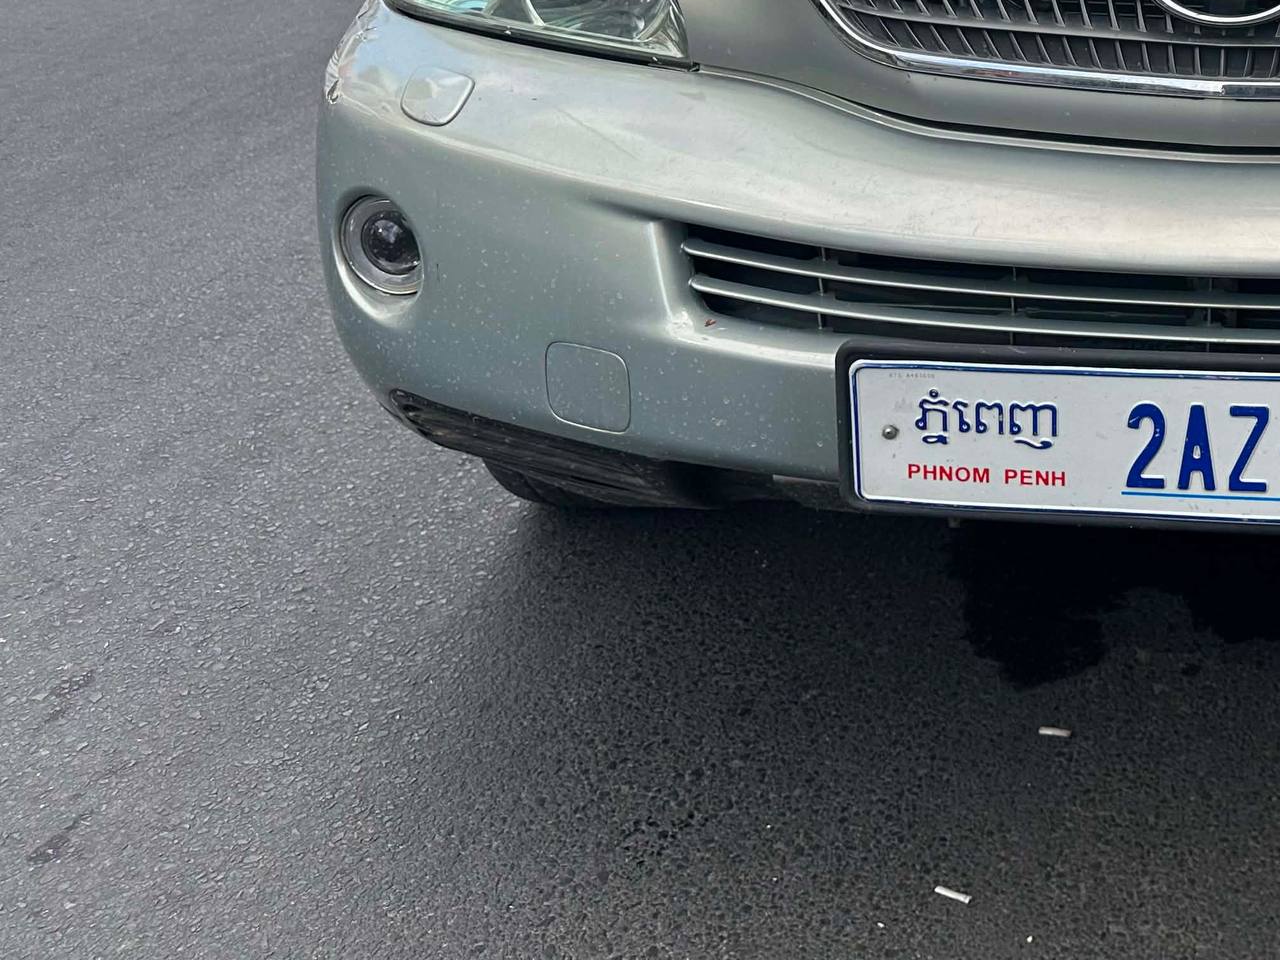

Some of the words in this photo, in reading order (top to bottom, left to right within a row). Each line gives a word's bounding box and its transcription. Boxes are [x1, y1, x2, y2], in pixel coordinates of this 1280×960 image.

[914, 389, 1058, 450] ភ្នំពេញ
[908, 463, 990, 484] PHNOM
[1004, 469, 1067, 487] PENH
